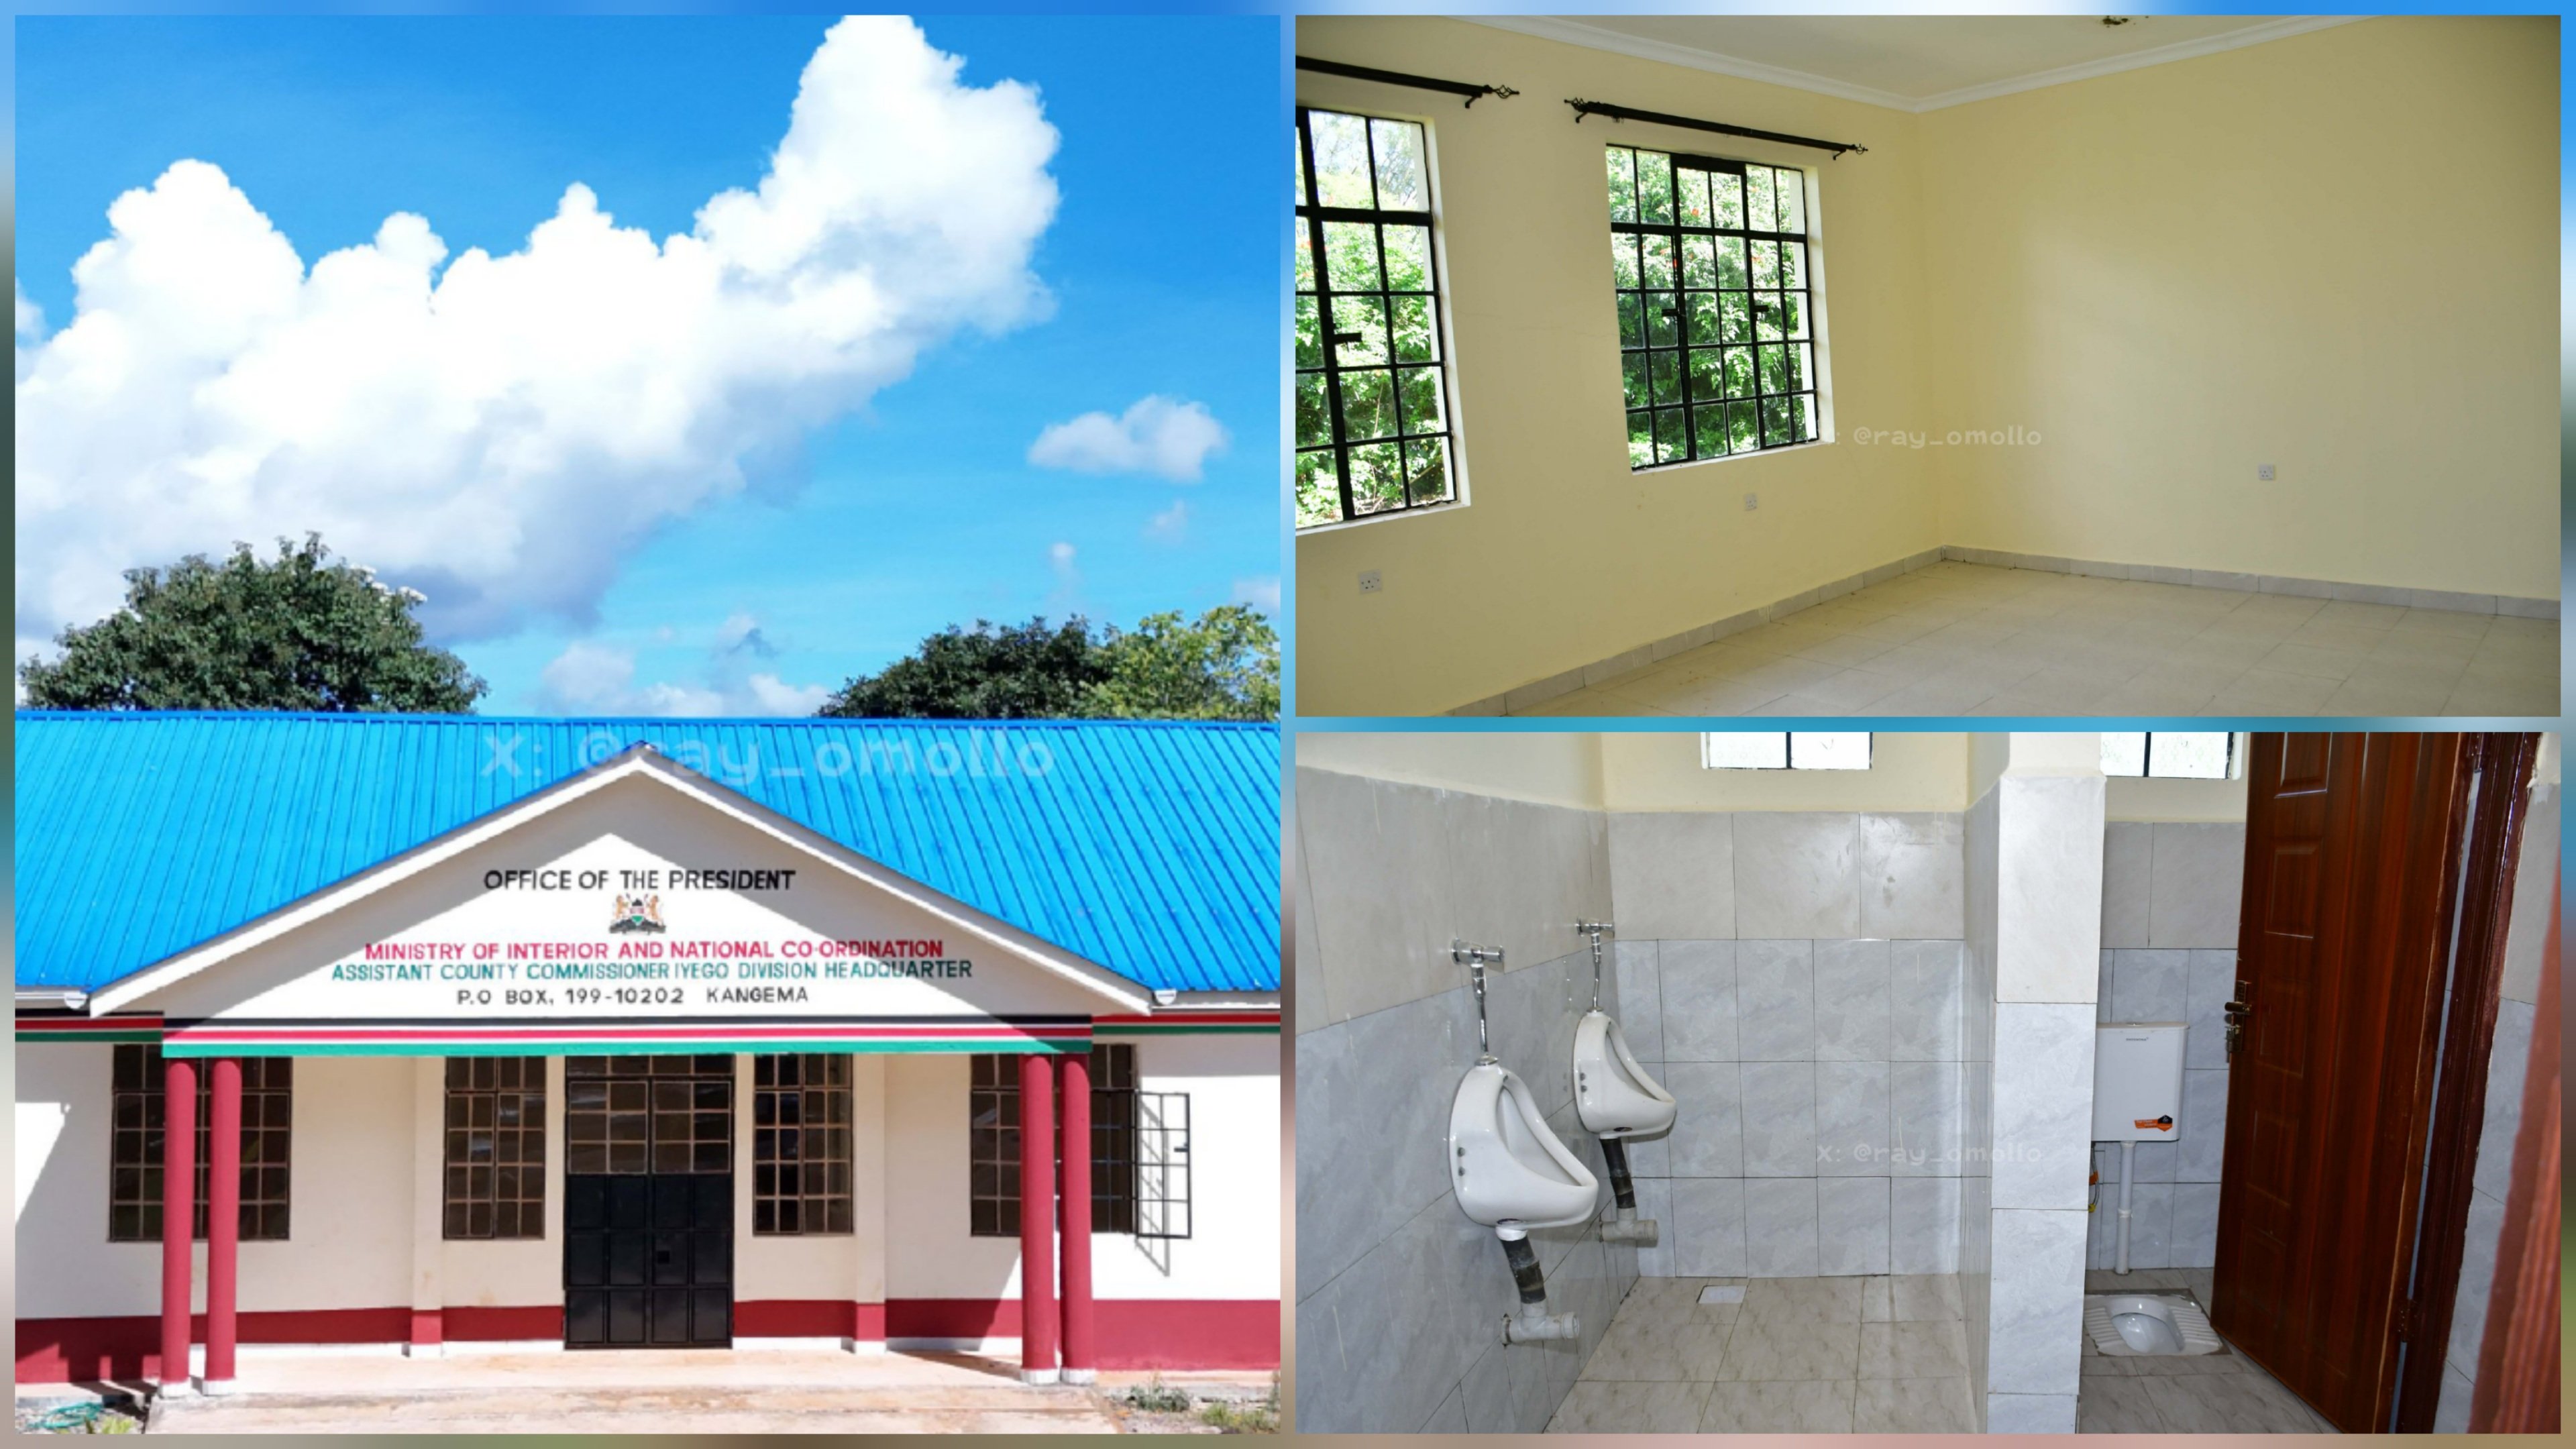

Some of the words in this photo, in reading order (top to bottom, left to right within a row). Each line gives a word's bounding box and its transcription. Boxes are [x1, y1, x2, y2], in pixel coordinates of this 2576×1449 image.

[484, 870, 572, 890] OFFICE
[578, 871, 609, 890] OF
[620, 871, 659, 890] THE
[669, 870, 796, 890] PRESIDENT
[366, 943, 466, 960] MINISTRY
[473, 943, 499, 959] OF
[507, 942, 608, 959] INTERIOR
[618, 942, 663, 959] AND
[671, 941, 774, 959] NATIONAL
[331, 964, 433, 981] ASSISTANT
[440, 963, 519, 980] COUNTY
[527, 962, 669, 979] COMMISSIONER
[675, 961, 729, 979] IYEGO
[738, 961, 817, 979] DIVISION
[825, 961, 973, 979] HEADQUARTER
[458, 989, 492, 1005] P.O
[565, 987, 684, 1004] 199-10202
[707, 986, 809, 1003] KANGEMA
